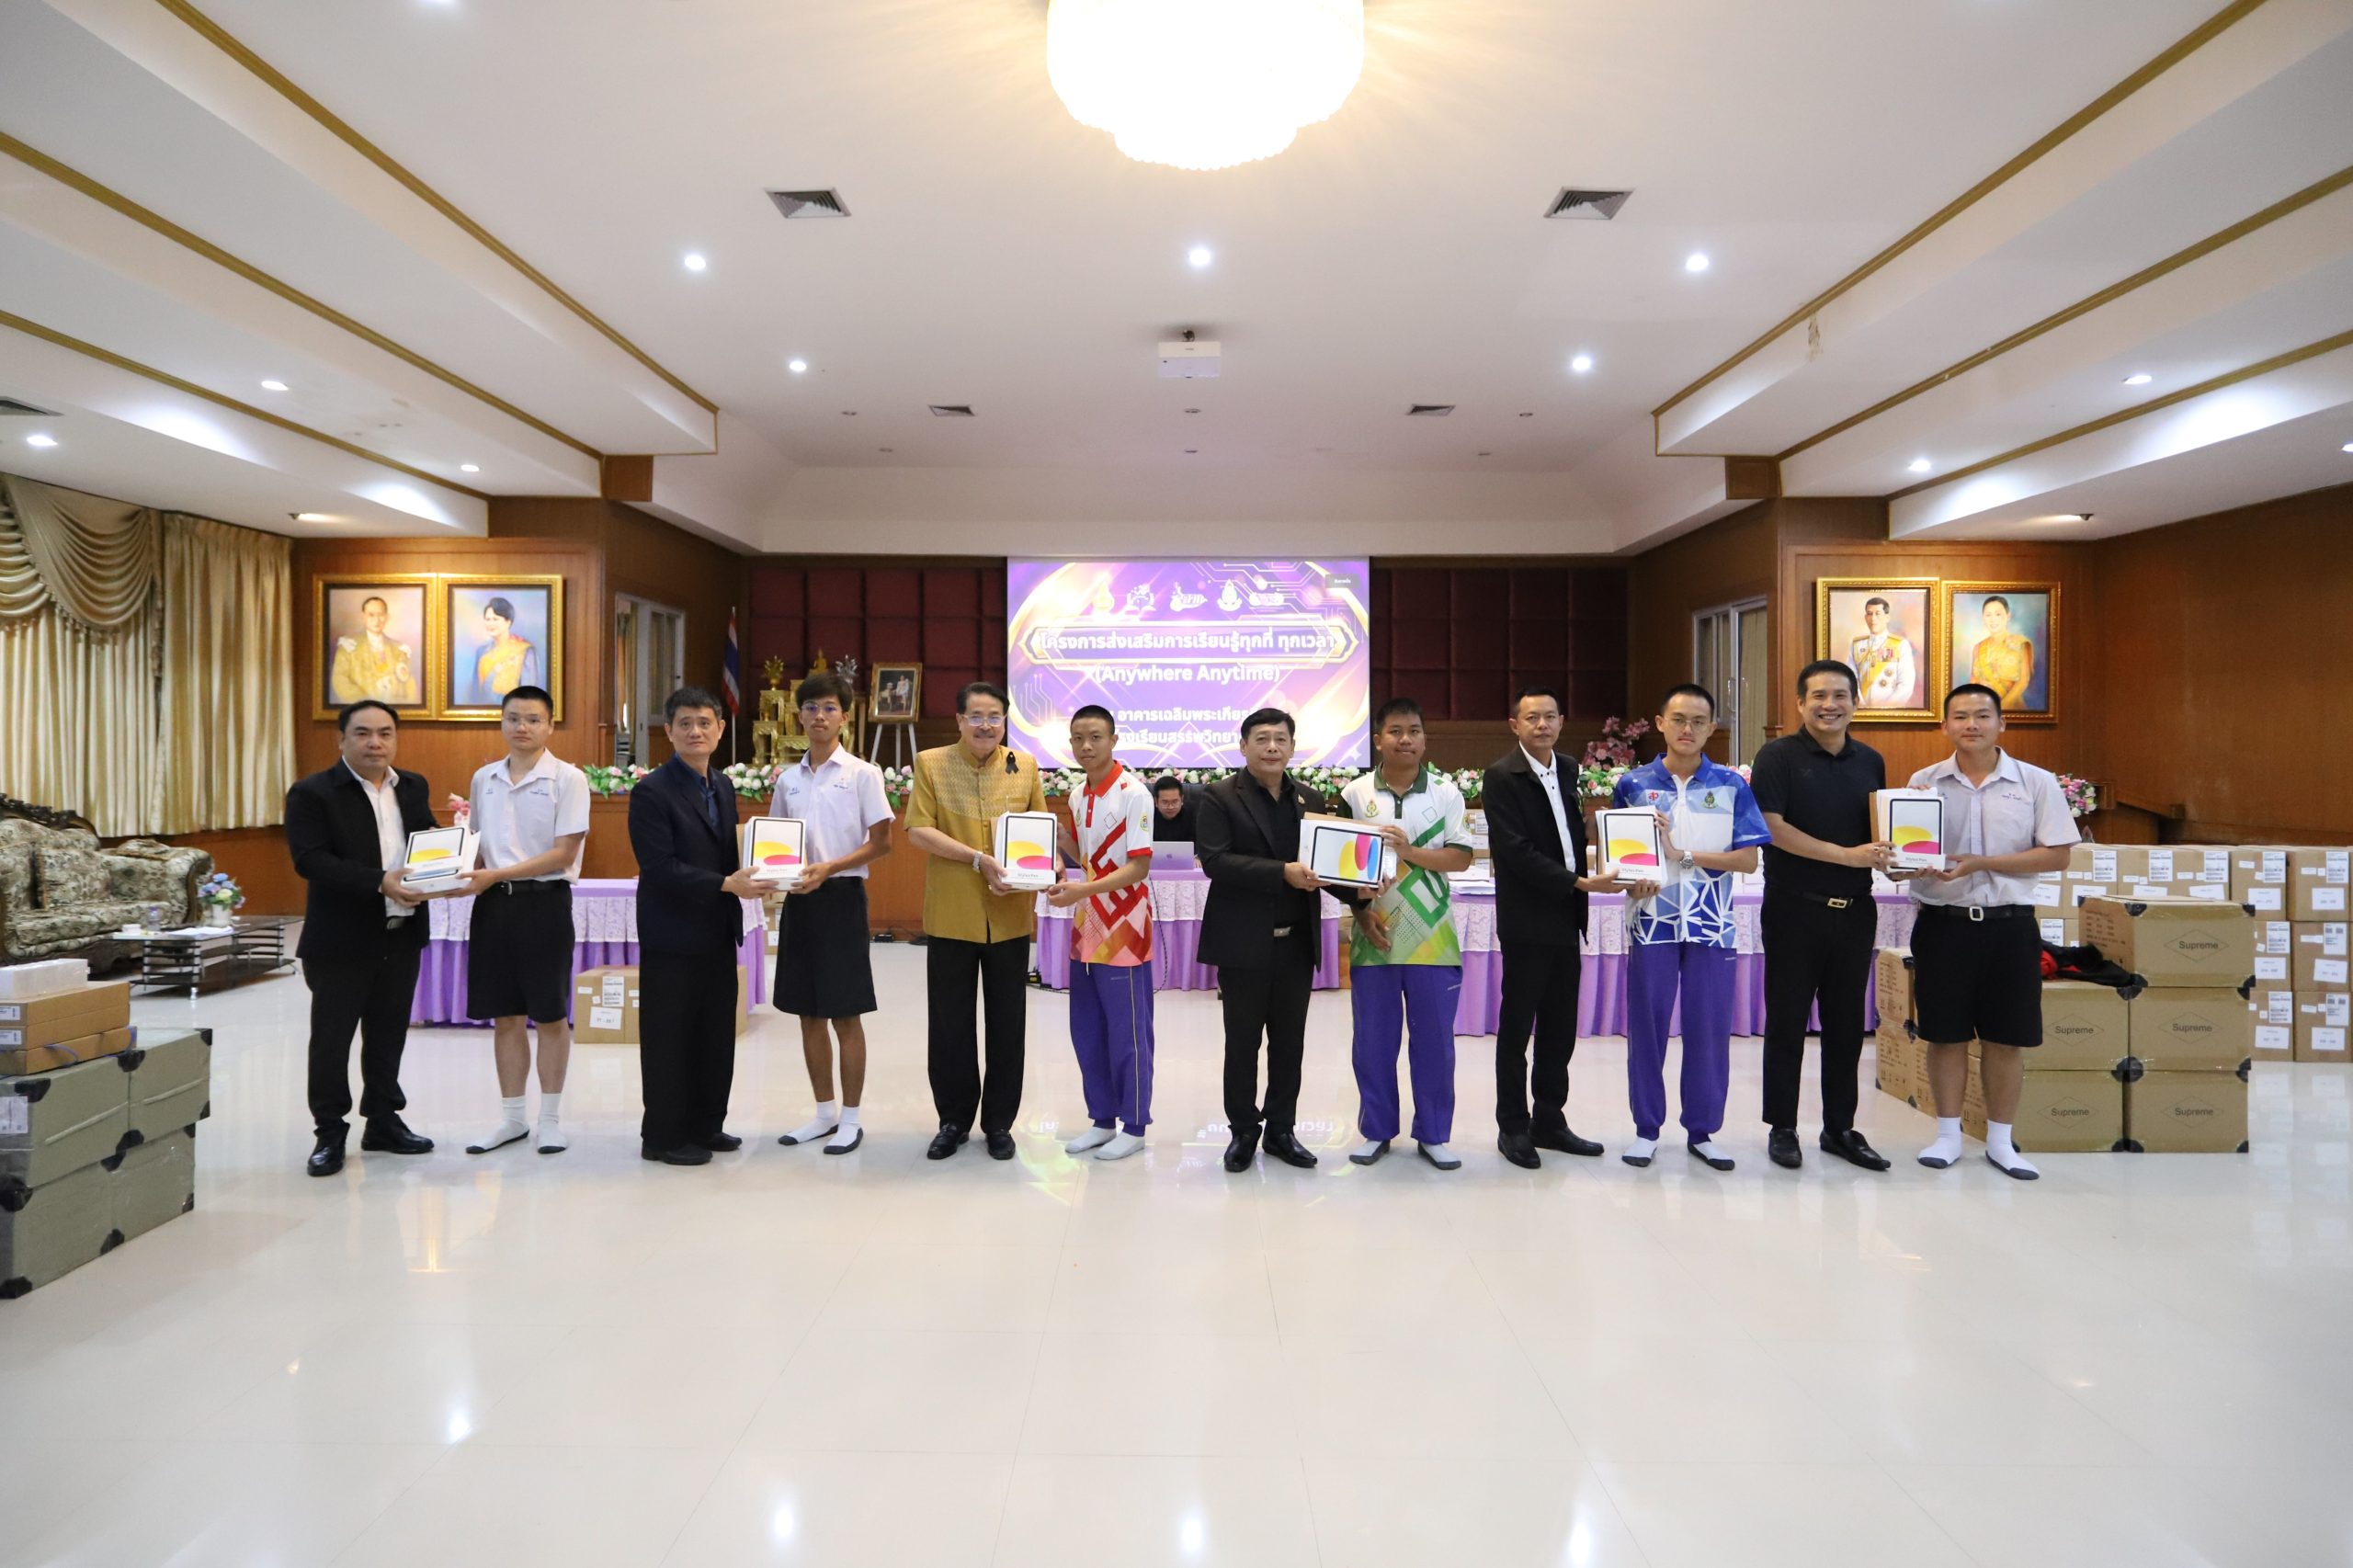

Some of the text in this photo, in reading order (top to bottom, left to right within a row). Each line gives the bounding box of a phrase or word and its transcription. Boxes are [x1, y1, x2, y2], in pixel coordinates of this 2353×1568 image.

[1040, 626, 1336, 653] โครงการส่งเสริมการเรียนรู้ทุกที่ ทุกเวลา
[1095, 664, 1280, 686] (Anywhere Anytime)
[2178, 940, 2219, 950] Supreme
[2054, 1025, 2095, 1036] Supreme
[2172, 1023, 2213, 1033] Supreme
[2051, 1108, 2089, 1118] Supreme
[2175, 1108, 2214, 1118] Supreme
